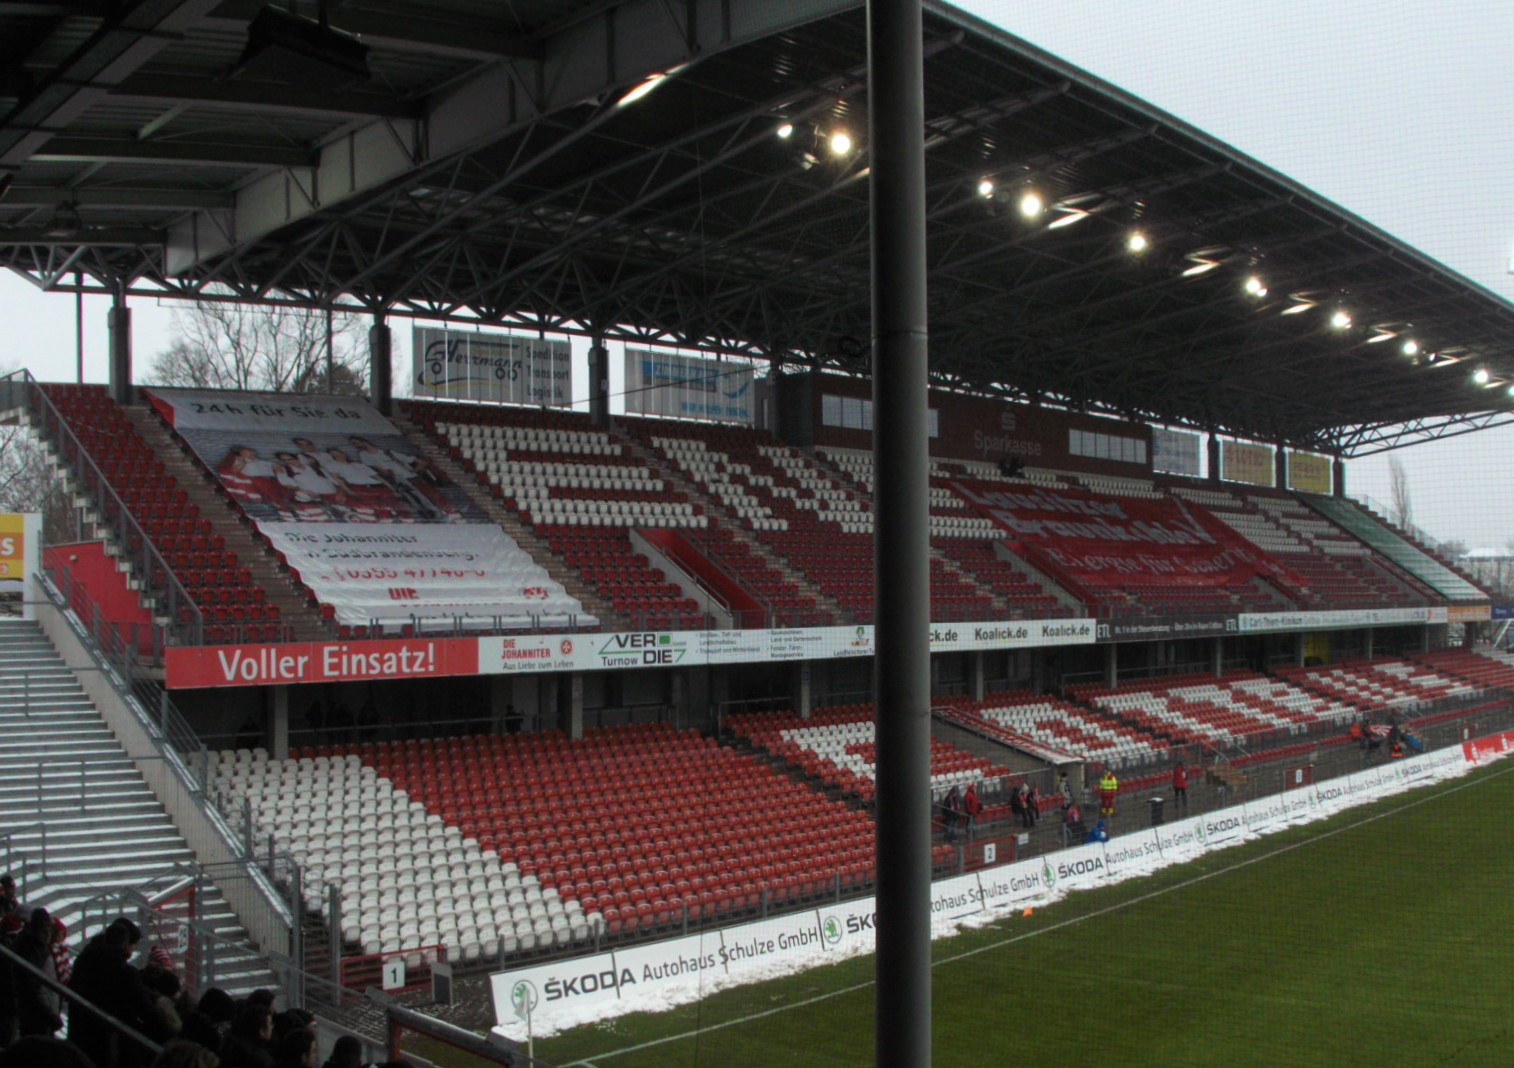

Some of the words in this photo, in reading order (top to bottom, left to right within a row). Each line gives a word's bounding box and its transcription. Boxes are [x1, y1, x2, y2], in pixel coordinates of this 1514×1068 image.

[251, 403, 285, 418] für
[292, 406, 329, 419] Sie
[334, 408, 362, 420] da
[974, 430, 1041, 459] Sparkasse
[930, 629, 958, 642] ck.de
[975, 627, 1028, 641] Koalick.de
[1042, 624, 1090, 638] Koalick.de
[503, 639, 516, 648] DIE
[615, 633, 656, 648] VER
[502, 647, 551, 659] JOHANNITER
[643, 650, 673, 664] DIE
[218, 647, 309, 681] Voller
[322, 642, 436, 677] Einsatz!
[503, 661, 516, 670] Aus
[518, 660, 536, 670] Liebe
[554, 660, 574, 669] Leben
[602, 656, 638, 667] Turnow
[1316, 787, 1343, 803] ŠKODA
[1206, 818, 1240, 836] ŠKODA
[1241, 811, 1269, 827] Autohaus
[1269, 803, 1291, 818] Schulze
[1291, 800, 1307, 811] GmbH
[987, 847, 993, 860] 2
[1058, 856, 1103, 880] ŠKODA
[1106, 844, 1144, 866] Autohaus
[1144, 837, 1173, 858] Schulze
[1173, 830, 1193, 846] GmbH
[930, 893, 967, 914] tohaus
[969, 880, 1009, 904] Schulze
[1010, 872, 1040, 893] GmbH
[544, 967, 636, 1002] ŠKODA
[642, 952, 715, 982] Autohaus
[718, 934, 775, 965] Schulze
[778, 926, 819, 950] GmbH
[391, 967, 397, 984] 1
